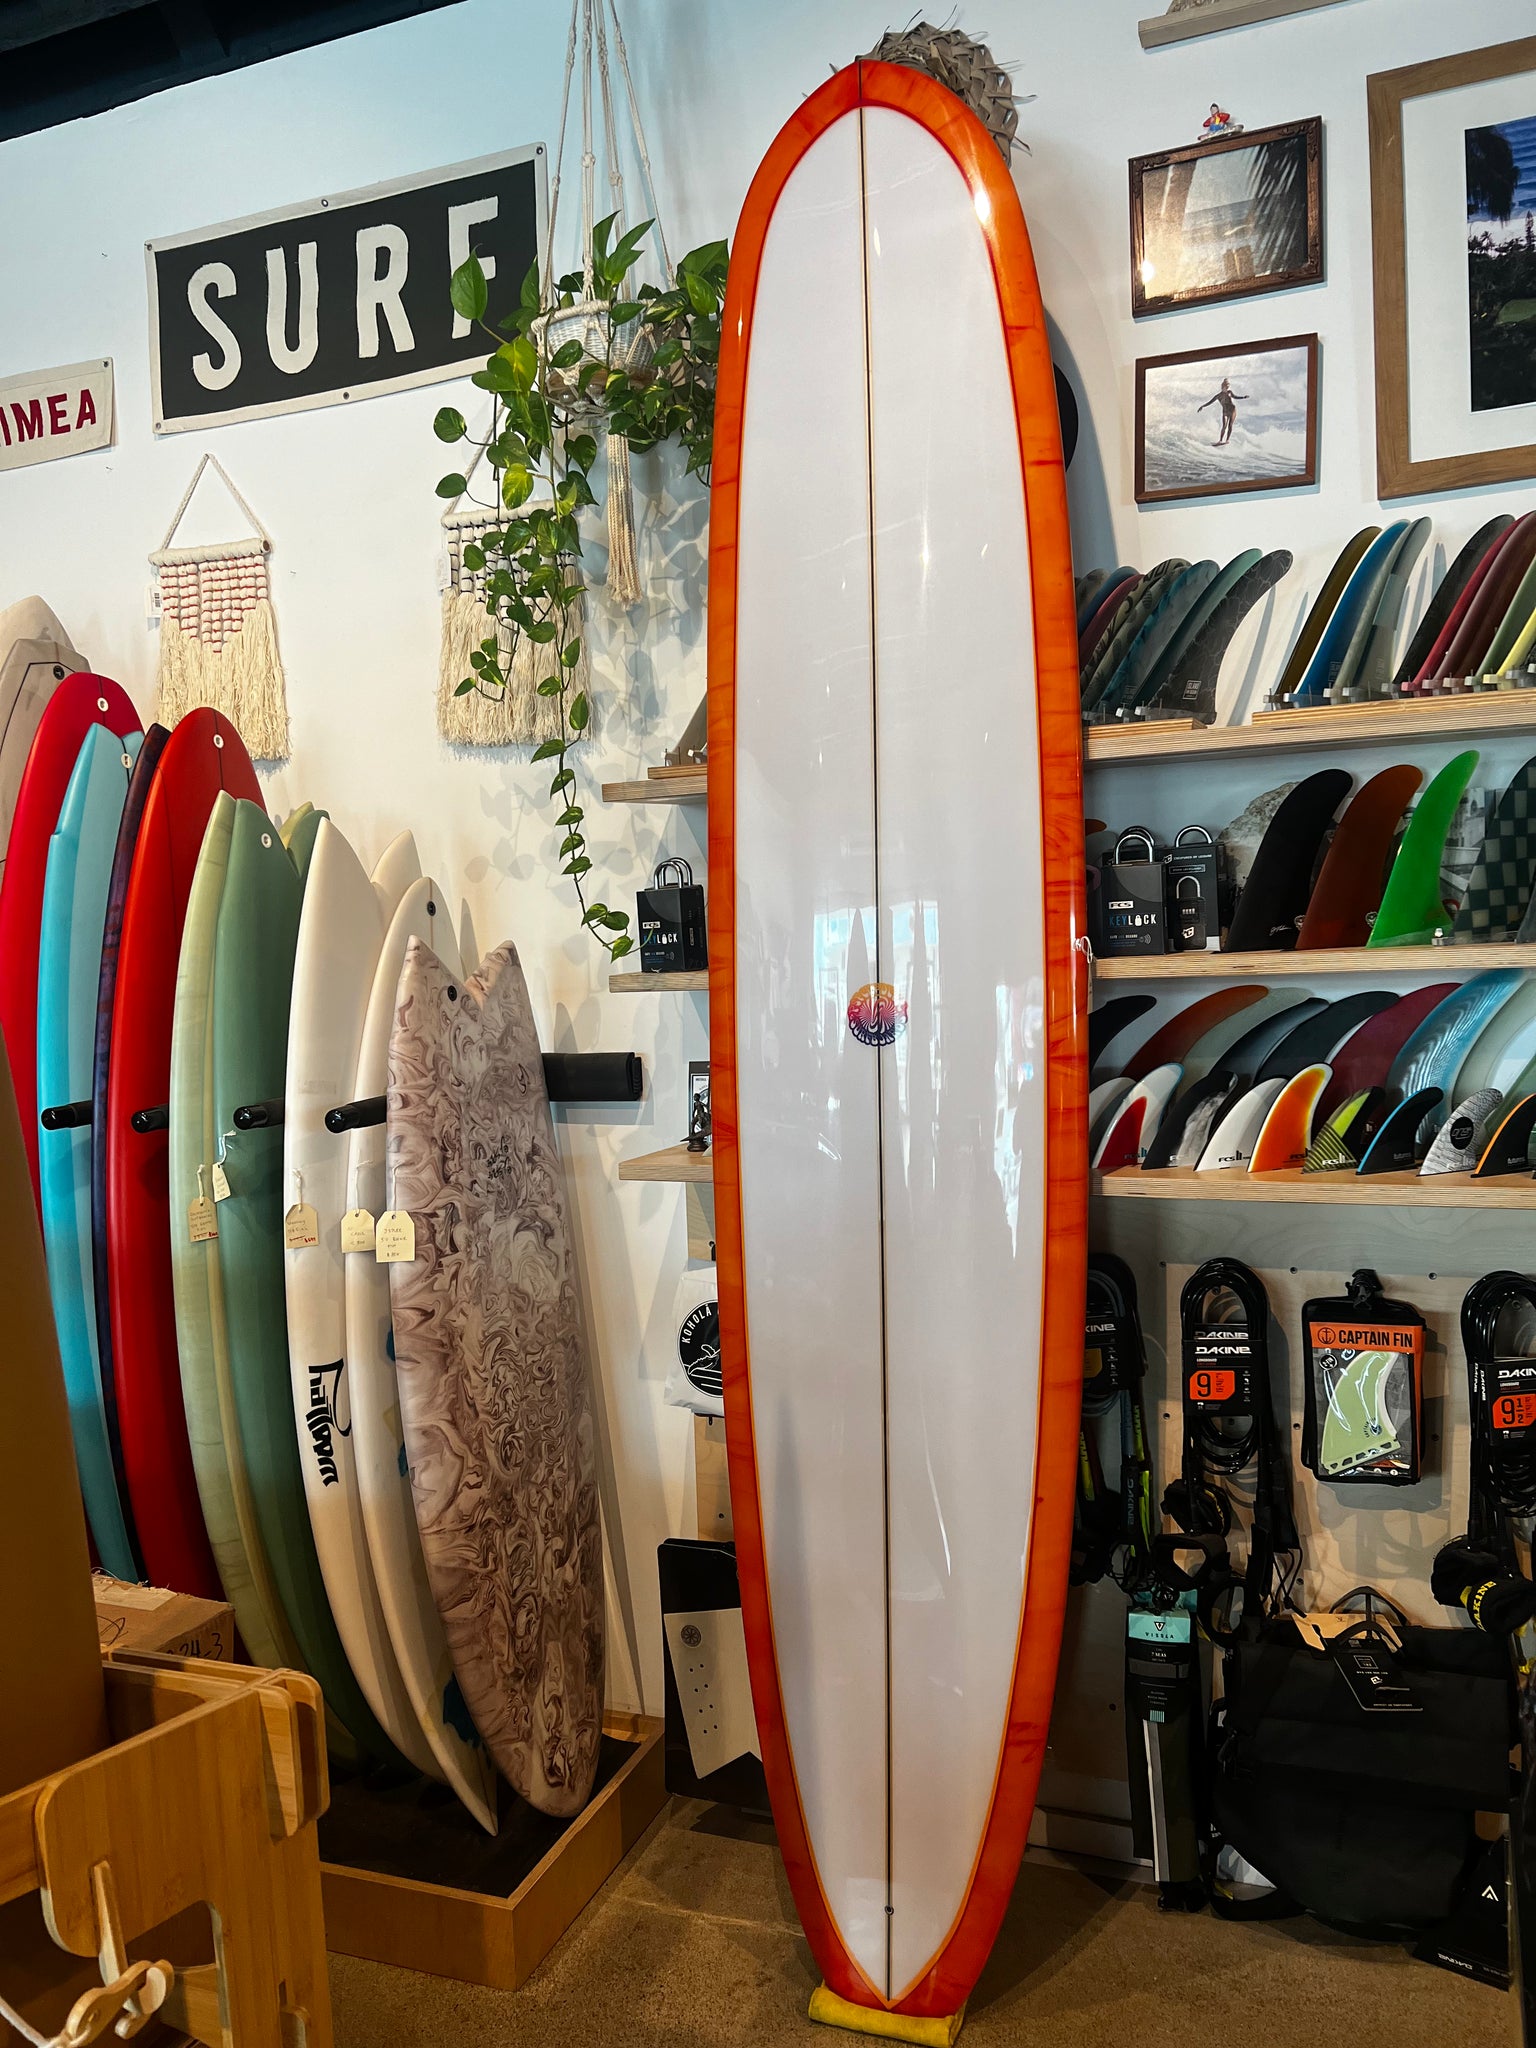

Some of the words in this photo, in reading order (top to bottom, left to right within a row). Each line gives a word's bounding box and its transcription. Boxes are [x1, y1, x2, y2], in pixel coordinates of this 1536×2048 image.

[187, 196, 498, 391] SURF
[1338, 1329, 1390, 1346] CAPTAIN
[1393, 1332, 1413, 1348] FIN
[1195, 1346, 1252, 1354] DAKINE
[1197, 1373, 1211, 1397] 9
